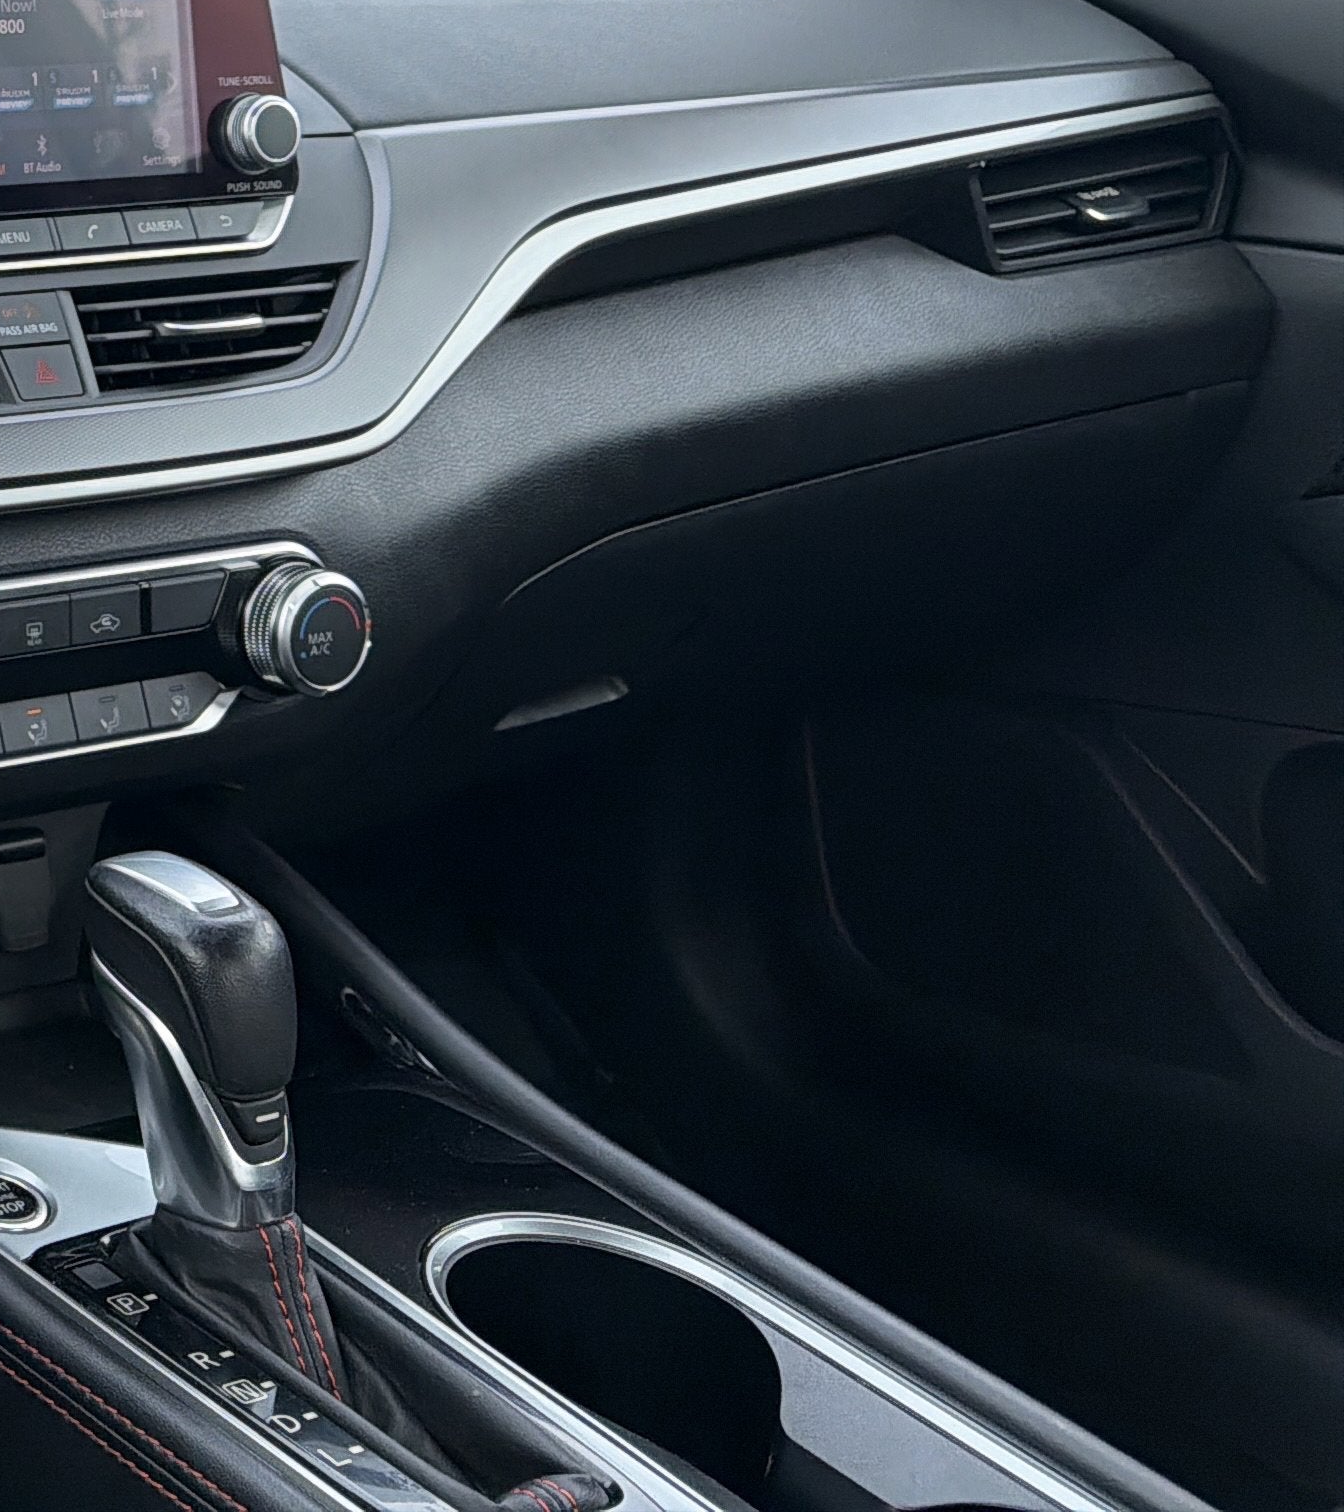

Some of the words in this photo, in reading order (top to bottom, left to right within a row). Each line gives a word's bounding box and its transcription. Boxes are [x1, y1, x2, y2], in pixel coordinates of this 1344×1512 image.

[23, 162, 35, 174] BT
[36, 160, 62, 173] Audio
[226, 182, 251, 193] PUSH
[253, 179, 282, 191] SOUND
[137, 219, 183, 234] CAMERA
[0, 325, 22, 336] PASS
[307, 631, 333, 645] MAX
[310, 643, 331, 657] A/C
[122, 1297, 135, 1312] P
[188, 1351, 221, 1370] R
[236, 1384, 260, 1400] N
[265, 1414, 301, 1434] D
[316, 1448, 353, 1467] L
